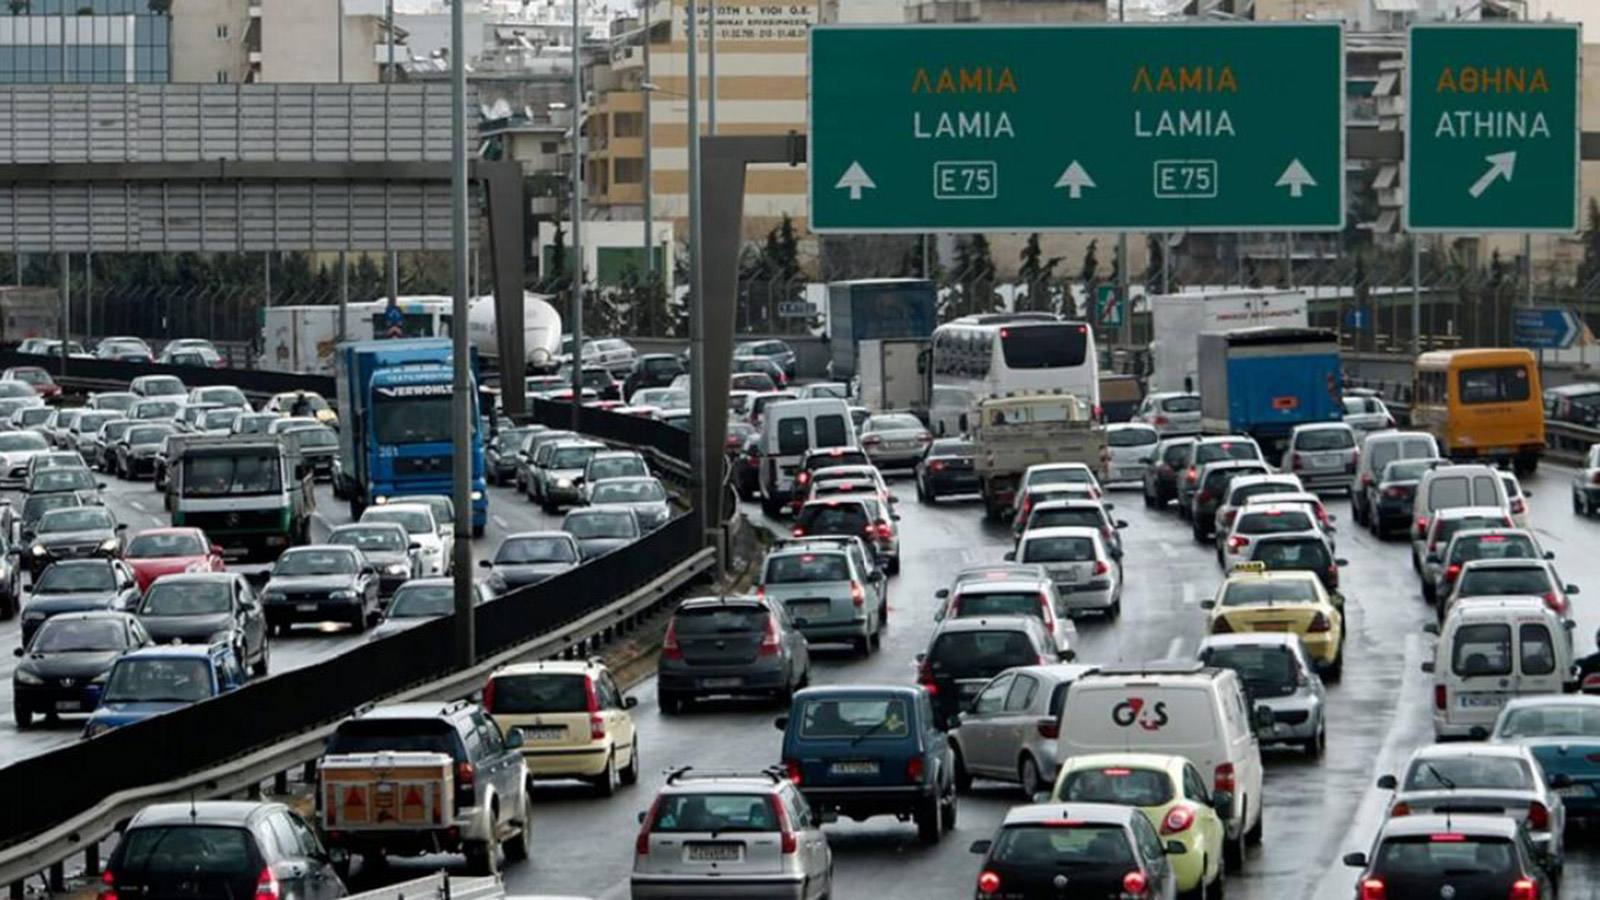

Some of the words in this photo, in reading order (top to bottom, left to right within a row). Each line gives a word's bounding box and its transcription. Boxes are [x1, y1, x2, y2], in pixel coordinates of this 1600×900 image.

[911, 69, 1018, 94] ΛΑΜΙΑ
[1131, 66, 1238, 93] ΛΑΜΙΑ
[1437, 68, 1549, 94] ΑΘΗΝΑ
[913, 111, 1015, 138] LAMIA
[1134, 110, 1236, 137] LAMIA
[1434, 111, 1551, 139] ATHINA
[940, 168, 956, 192] E
[961, 168, 991, 192] 75
[1160, 167, 1176, 190] E
[1180, 167, 1211, 190] 75
[1111, 692, 1169, 731] G4S
